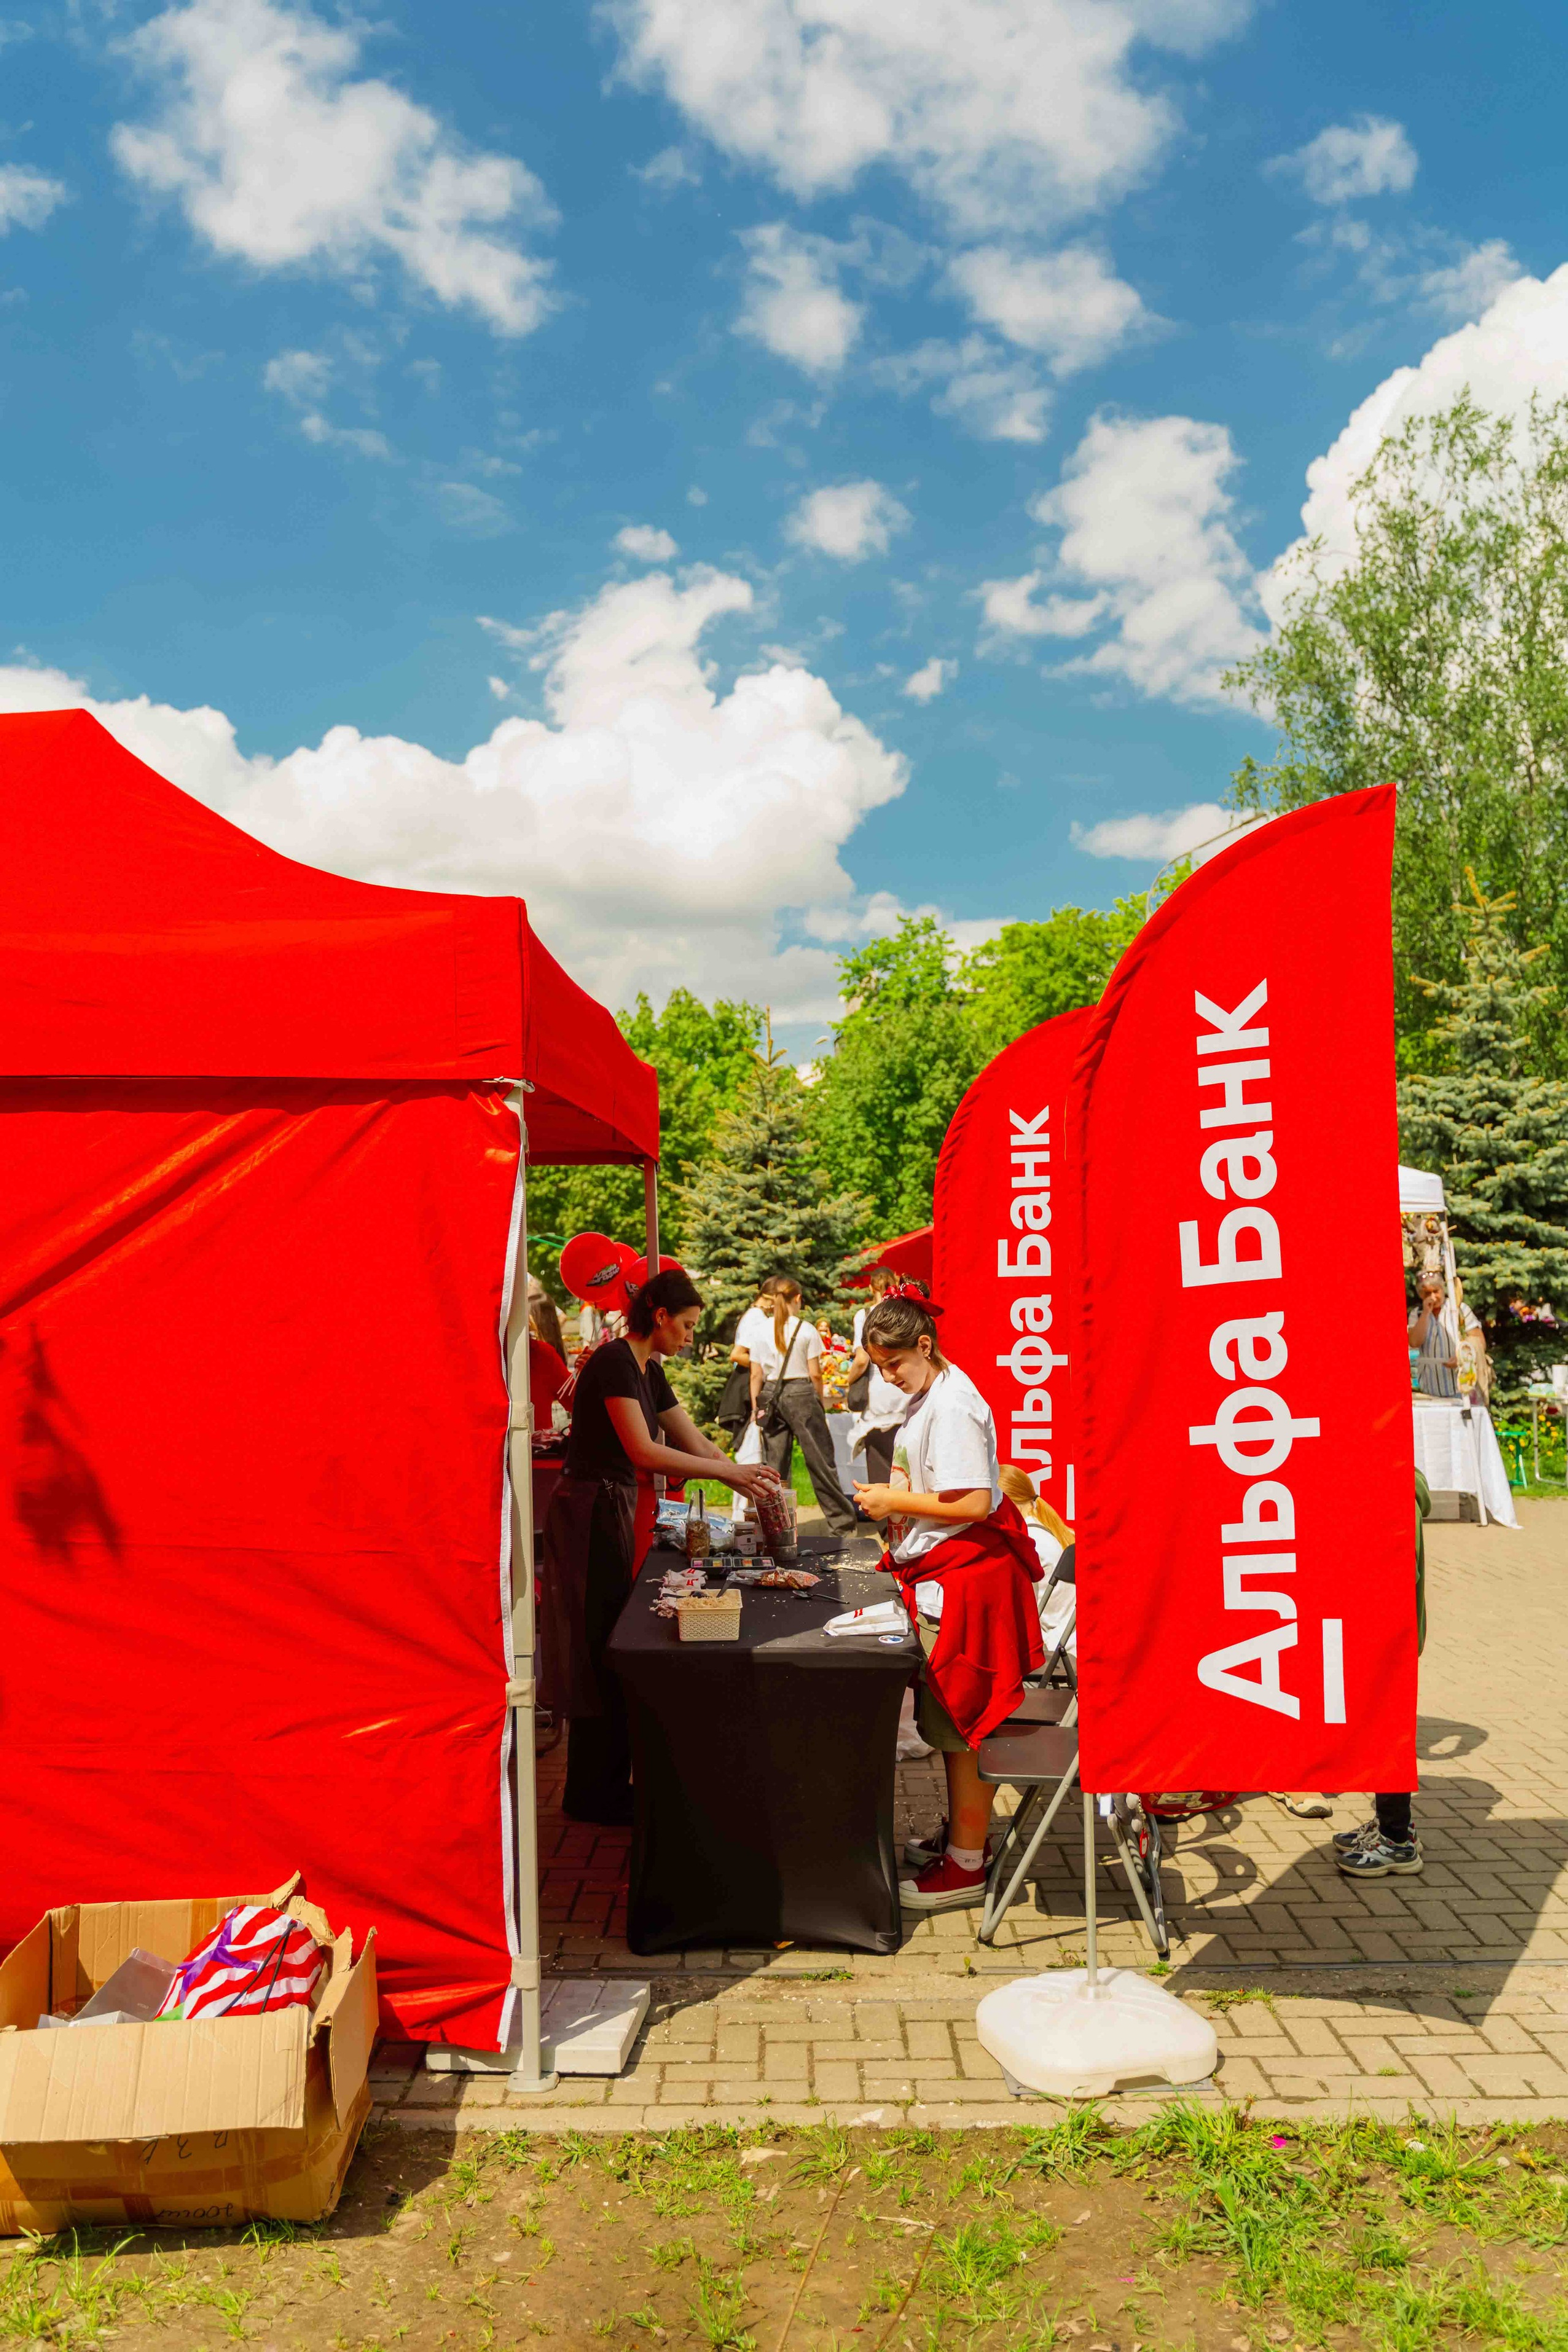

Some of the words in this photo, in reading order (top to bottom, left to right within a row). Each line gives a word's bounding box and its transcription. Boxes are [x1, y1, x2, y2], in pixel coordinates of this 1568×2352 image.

[997, 1105, 1052, 1278] Банк
[1178, 978, 1283, 1288] Банк
[1189, 1311, 1320, 1721] Альфа
